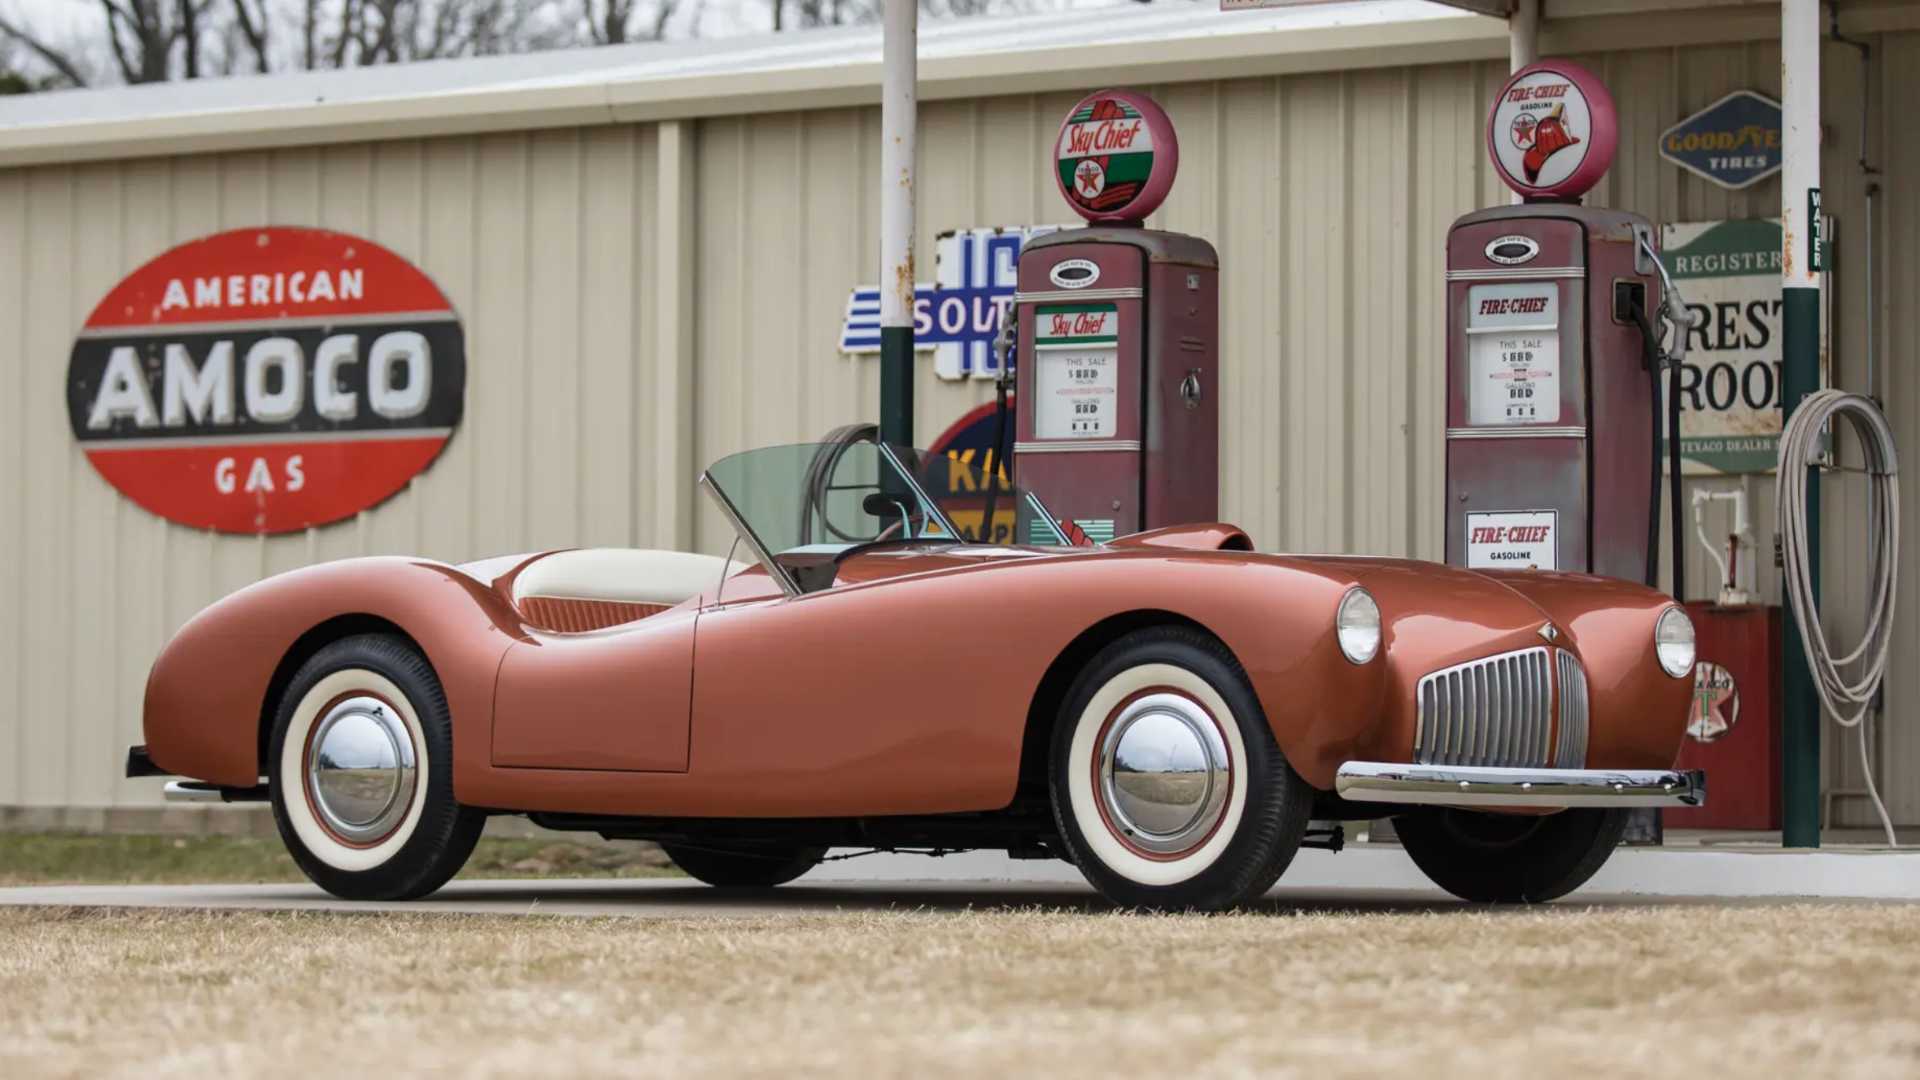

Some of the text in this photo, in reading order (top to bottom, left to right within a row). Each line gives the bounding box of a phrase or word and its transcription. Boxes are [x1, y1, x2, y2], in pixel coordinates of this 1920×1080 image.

[1507, 85, 1570, 102] FIRE-CHIEF
[1520, 102, 1552, 111] GASOLINE
[1067, 119, 1141, 155] Sky Chief
[1709, 155, 1767, 169] TIRES
[1676, 251, 1782, 273] REGISTER
[162, 269, 363, 310] AMERICAN
[1479, 297, 1549, 315] FIRE-CHIEF
[1050, 312, 1107, 337] Sky Chief
[1522, 339, 1543, 348] SALE
[1088, 358, 1107, 366] SALE
[86, 330, 432, 430] AMOCO
[1681, 441, 1723, 453] TEXACO
[1727, 438, 1771, 452] DEALER
[215, 455, 304, 494] GAS
[1471, 526, 1551, 544] FIRE-CHIEF
[1490, 551, 1532, 561] GASOLINE
